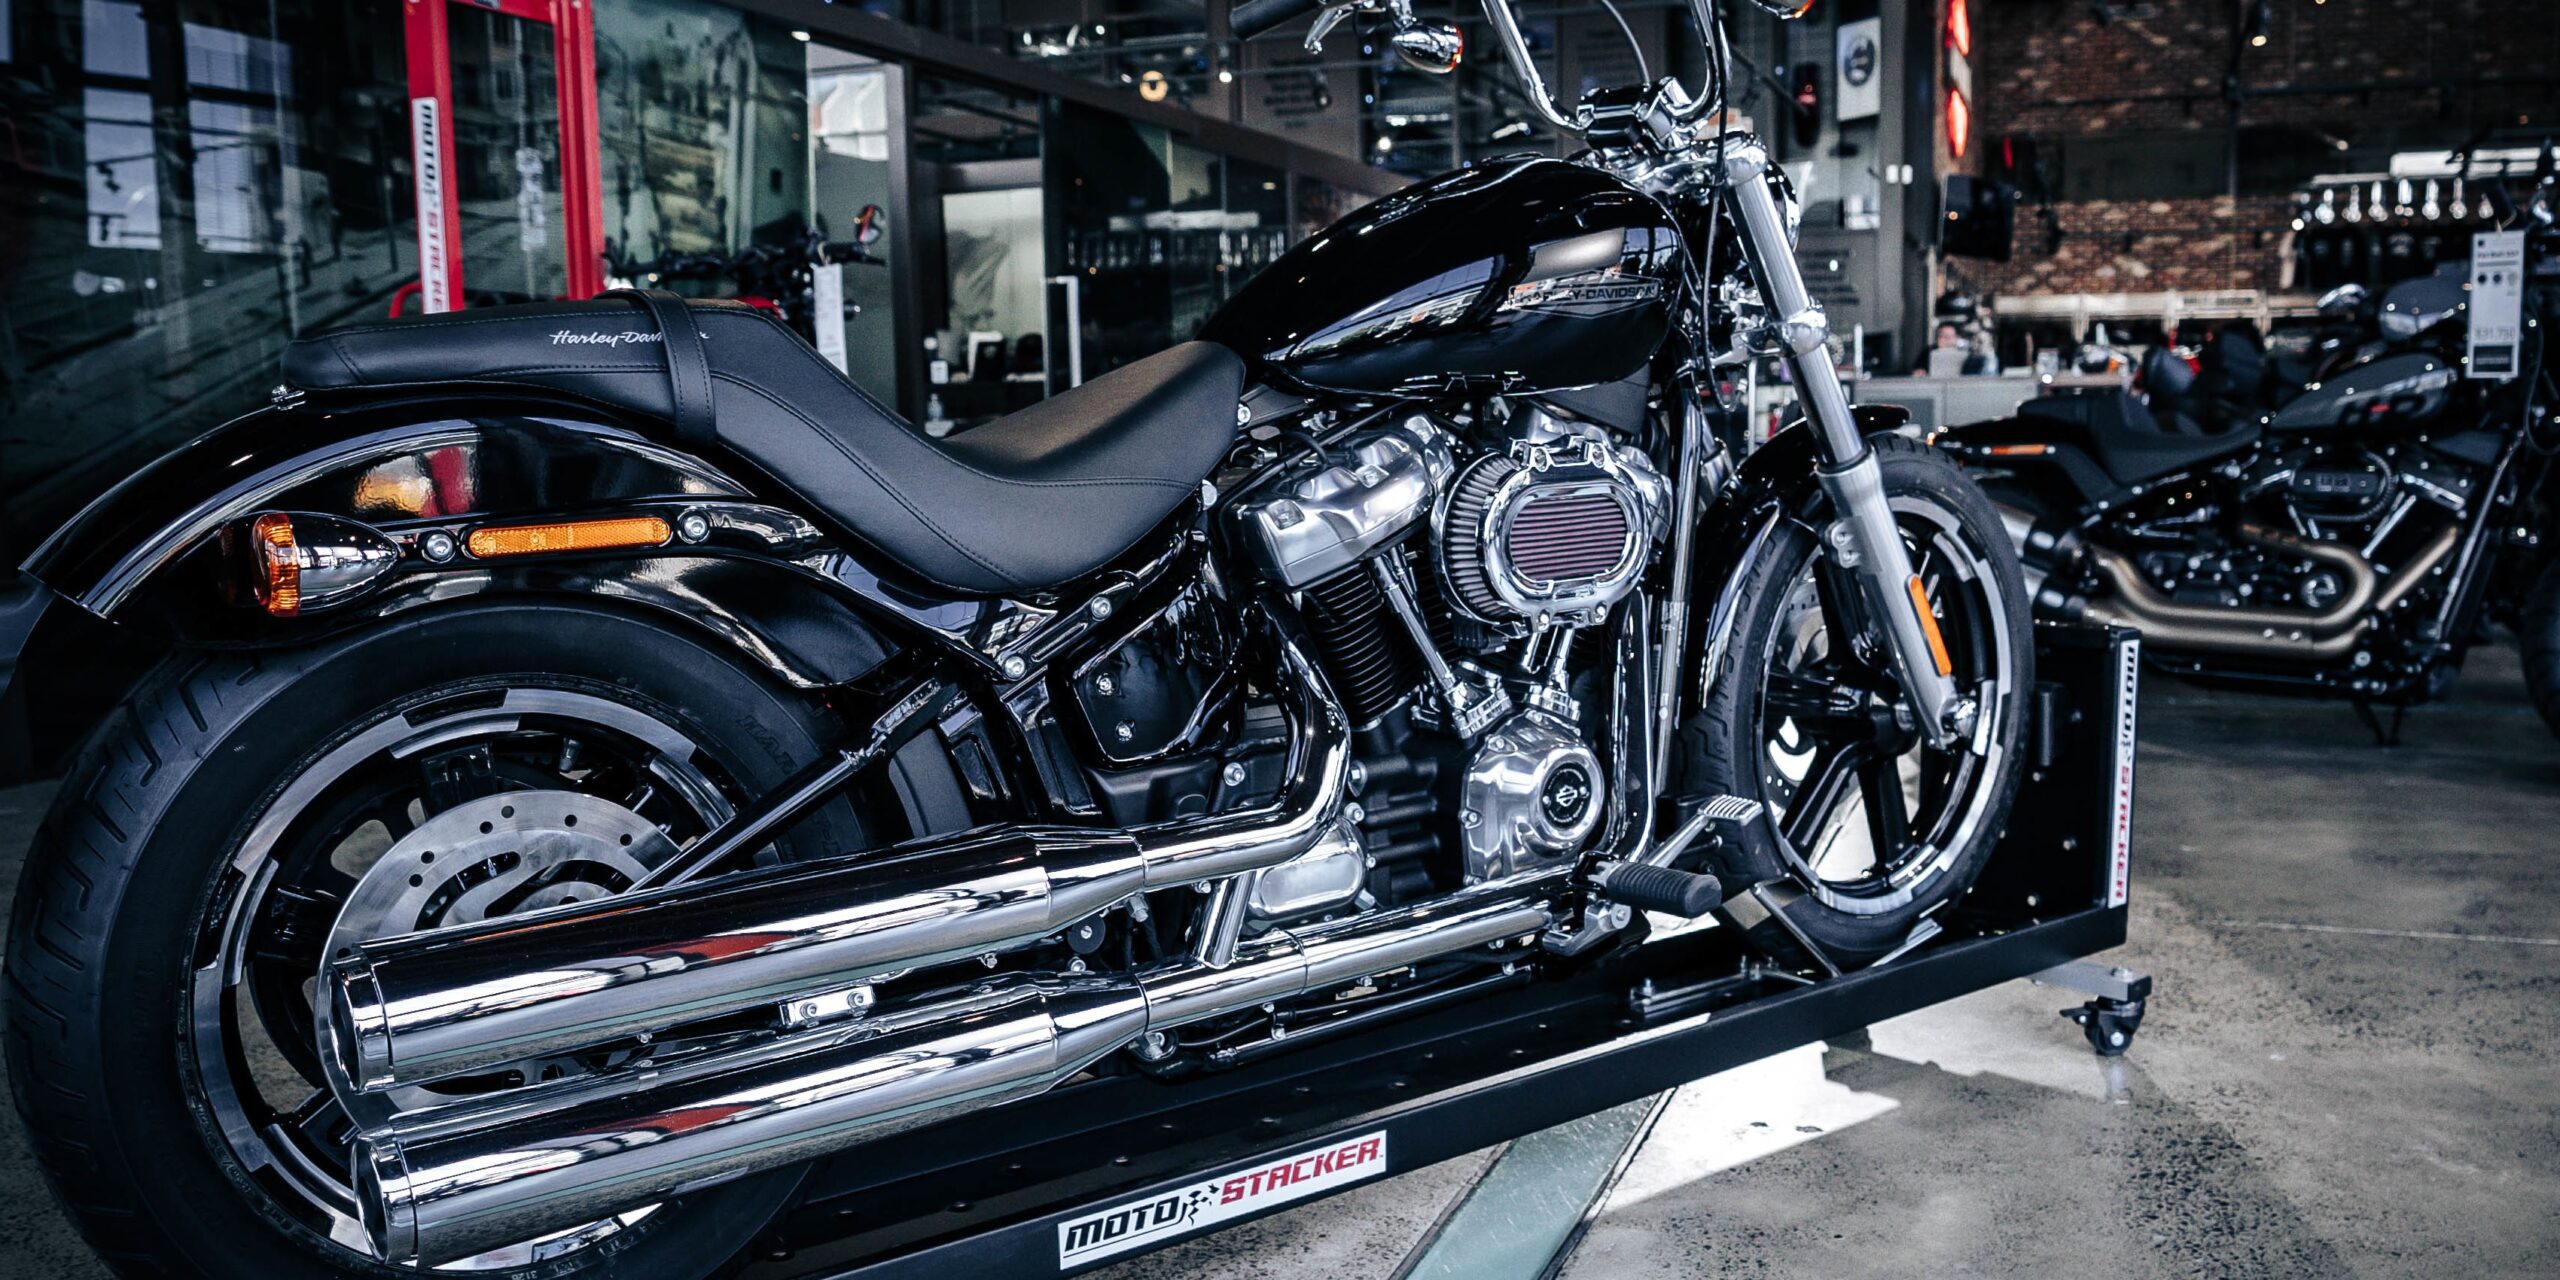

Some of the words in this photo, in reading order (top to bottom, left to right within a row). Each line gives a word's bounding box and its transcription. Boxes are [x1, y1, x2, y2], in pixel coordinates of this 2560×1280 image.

[421, 104, 436, 181] MOTO
[427, 212, 443, 311] STACKE
[1518, 286, 1656, 303] HARY-DAVIDSON
[549, 330, 709, 348] Harley-Davi
[2125, 646, 2136, 731] MOTO
[2115, 765, 2130, 899] STACKER
[1064, 1195, 1180, 1252] MOTO
[1220, 1137, 1381, 1205] STACKER
